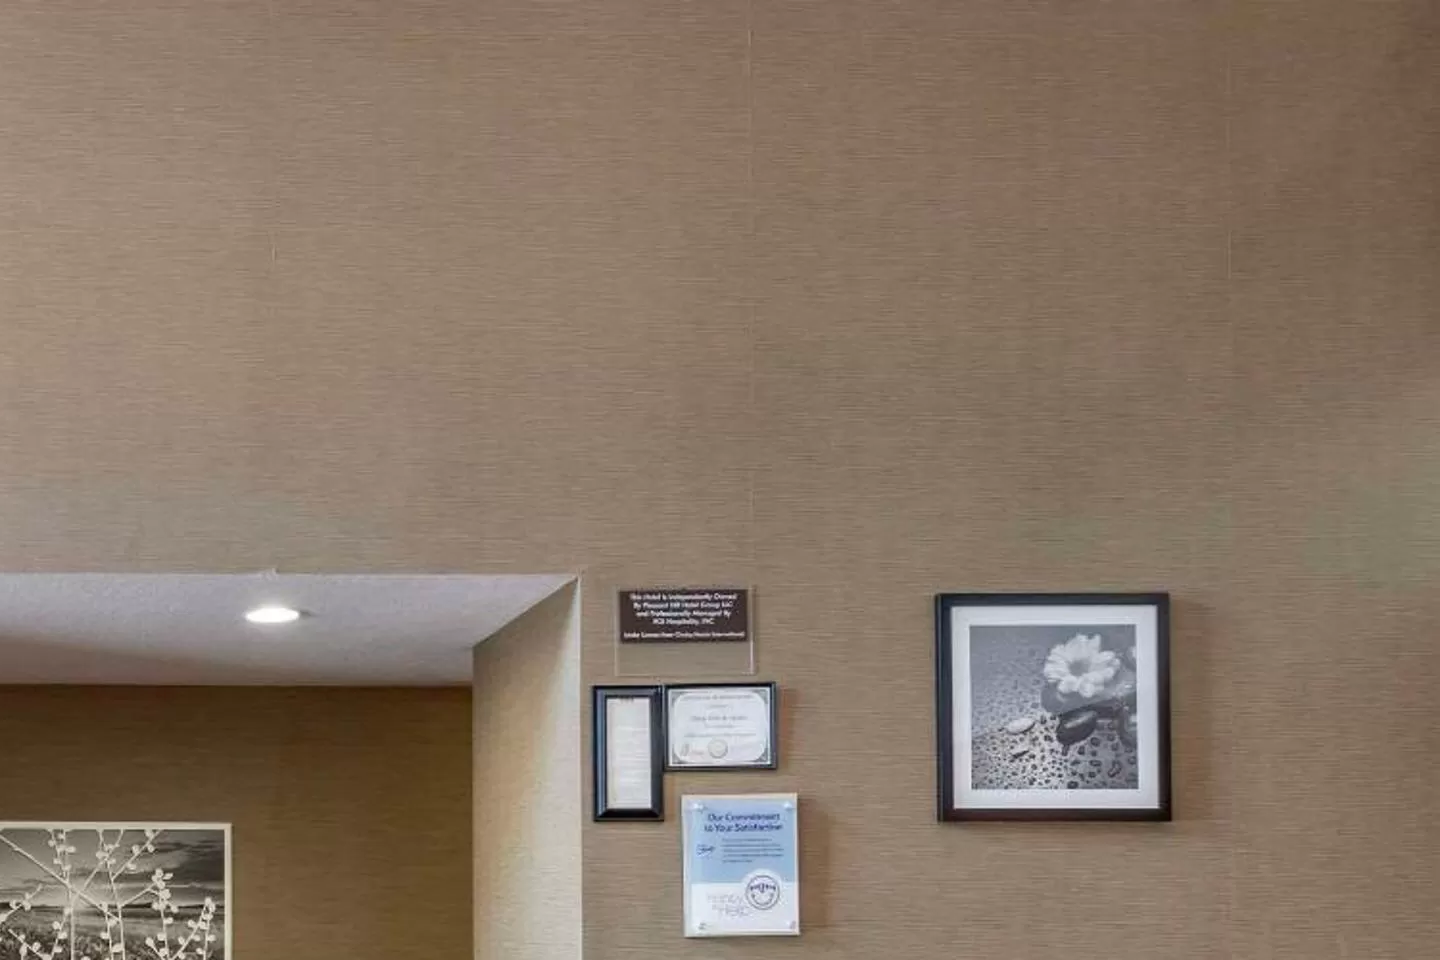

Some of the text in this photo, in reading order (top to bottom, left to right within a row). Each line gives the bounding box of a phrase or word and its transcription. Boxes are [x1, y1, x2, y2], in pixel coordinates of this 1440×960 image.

[714, 592, 737, 601] Owned
[708, 812, 781, 821] Our Commitment
[714, 823, 733, 832] Your
